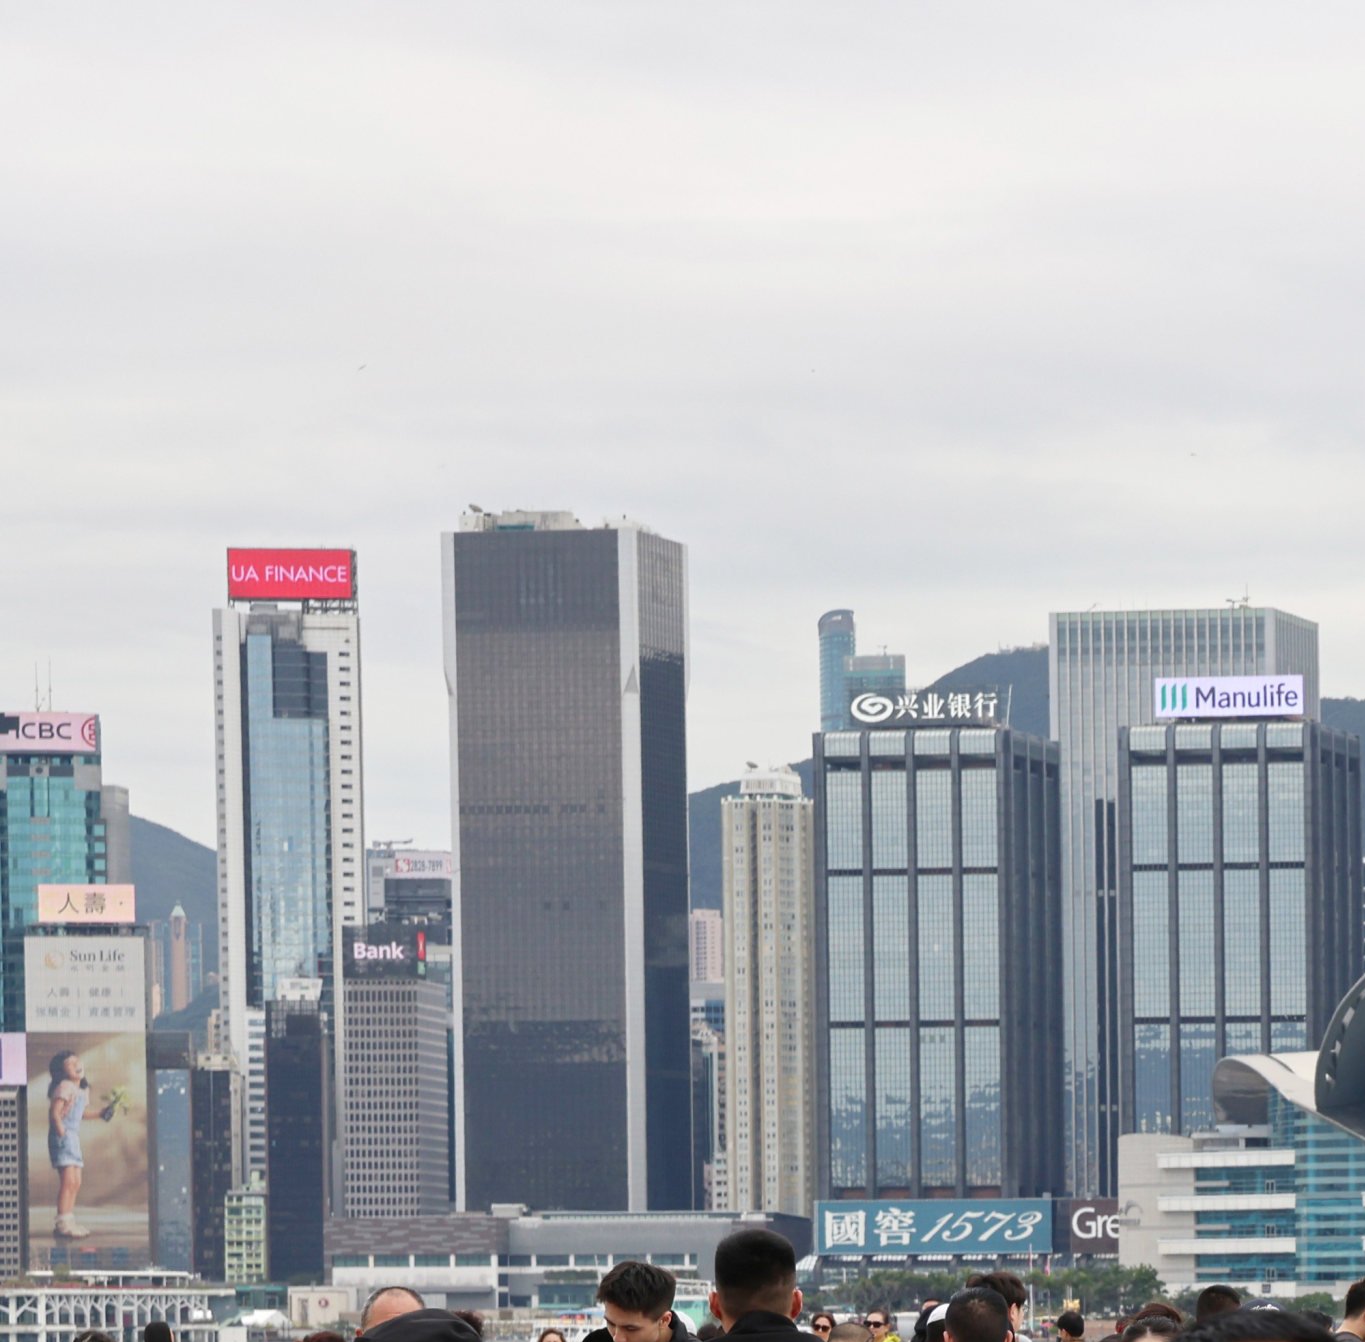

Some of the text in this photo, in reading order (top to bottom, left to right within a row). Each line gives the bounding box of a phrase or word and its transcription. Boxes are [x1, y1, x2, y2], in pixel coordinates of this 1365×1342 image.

[231, 565, 348, 582] UA FINANCE
[894, 692, 998, 719] 兴业银行
[1195, 682, 1298, 709] Manulife
[58, 892, 107, 914] 人壽
[69, 950, 125, 962] Sun Life
[353, 942, 404, 959] Bank
[824, 1207, 1043, 1248] 國窖 1573
